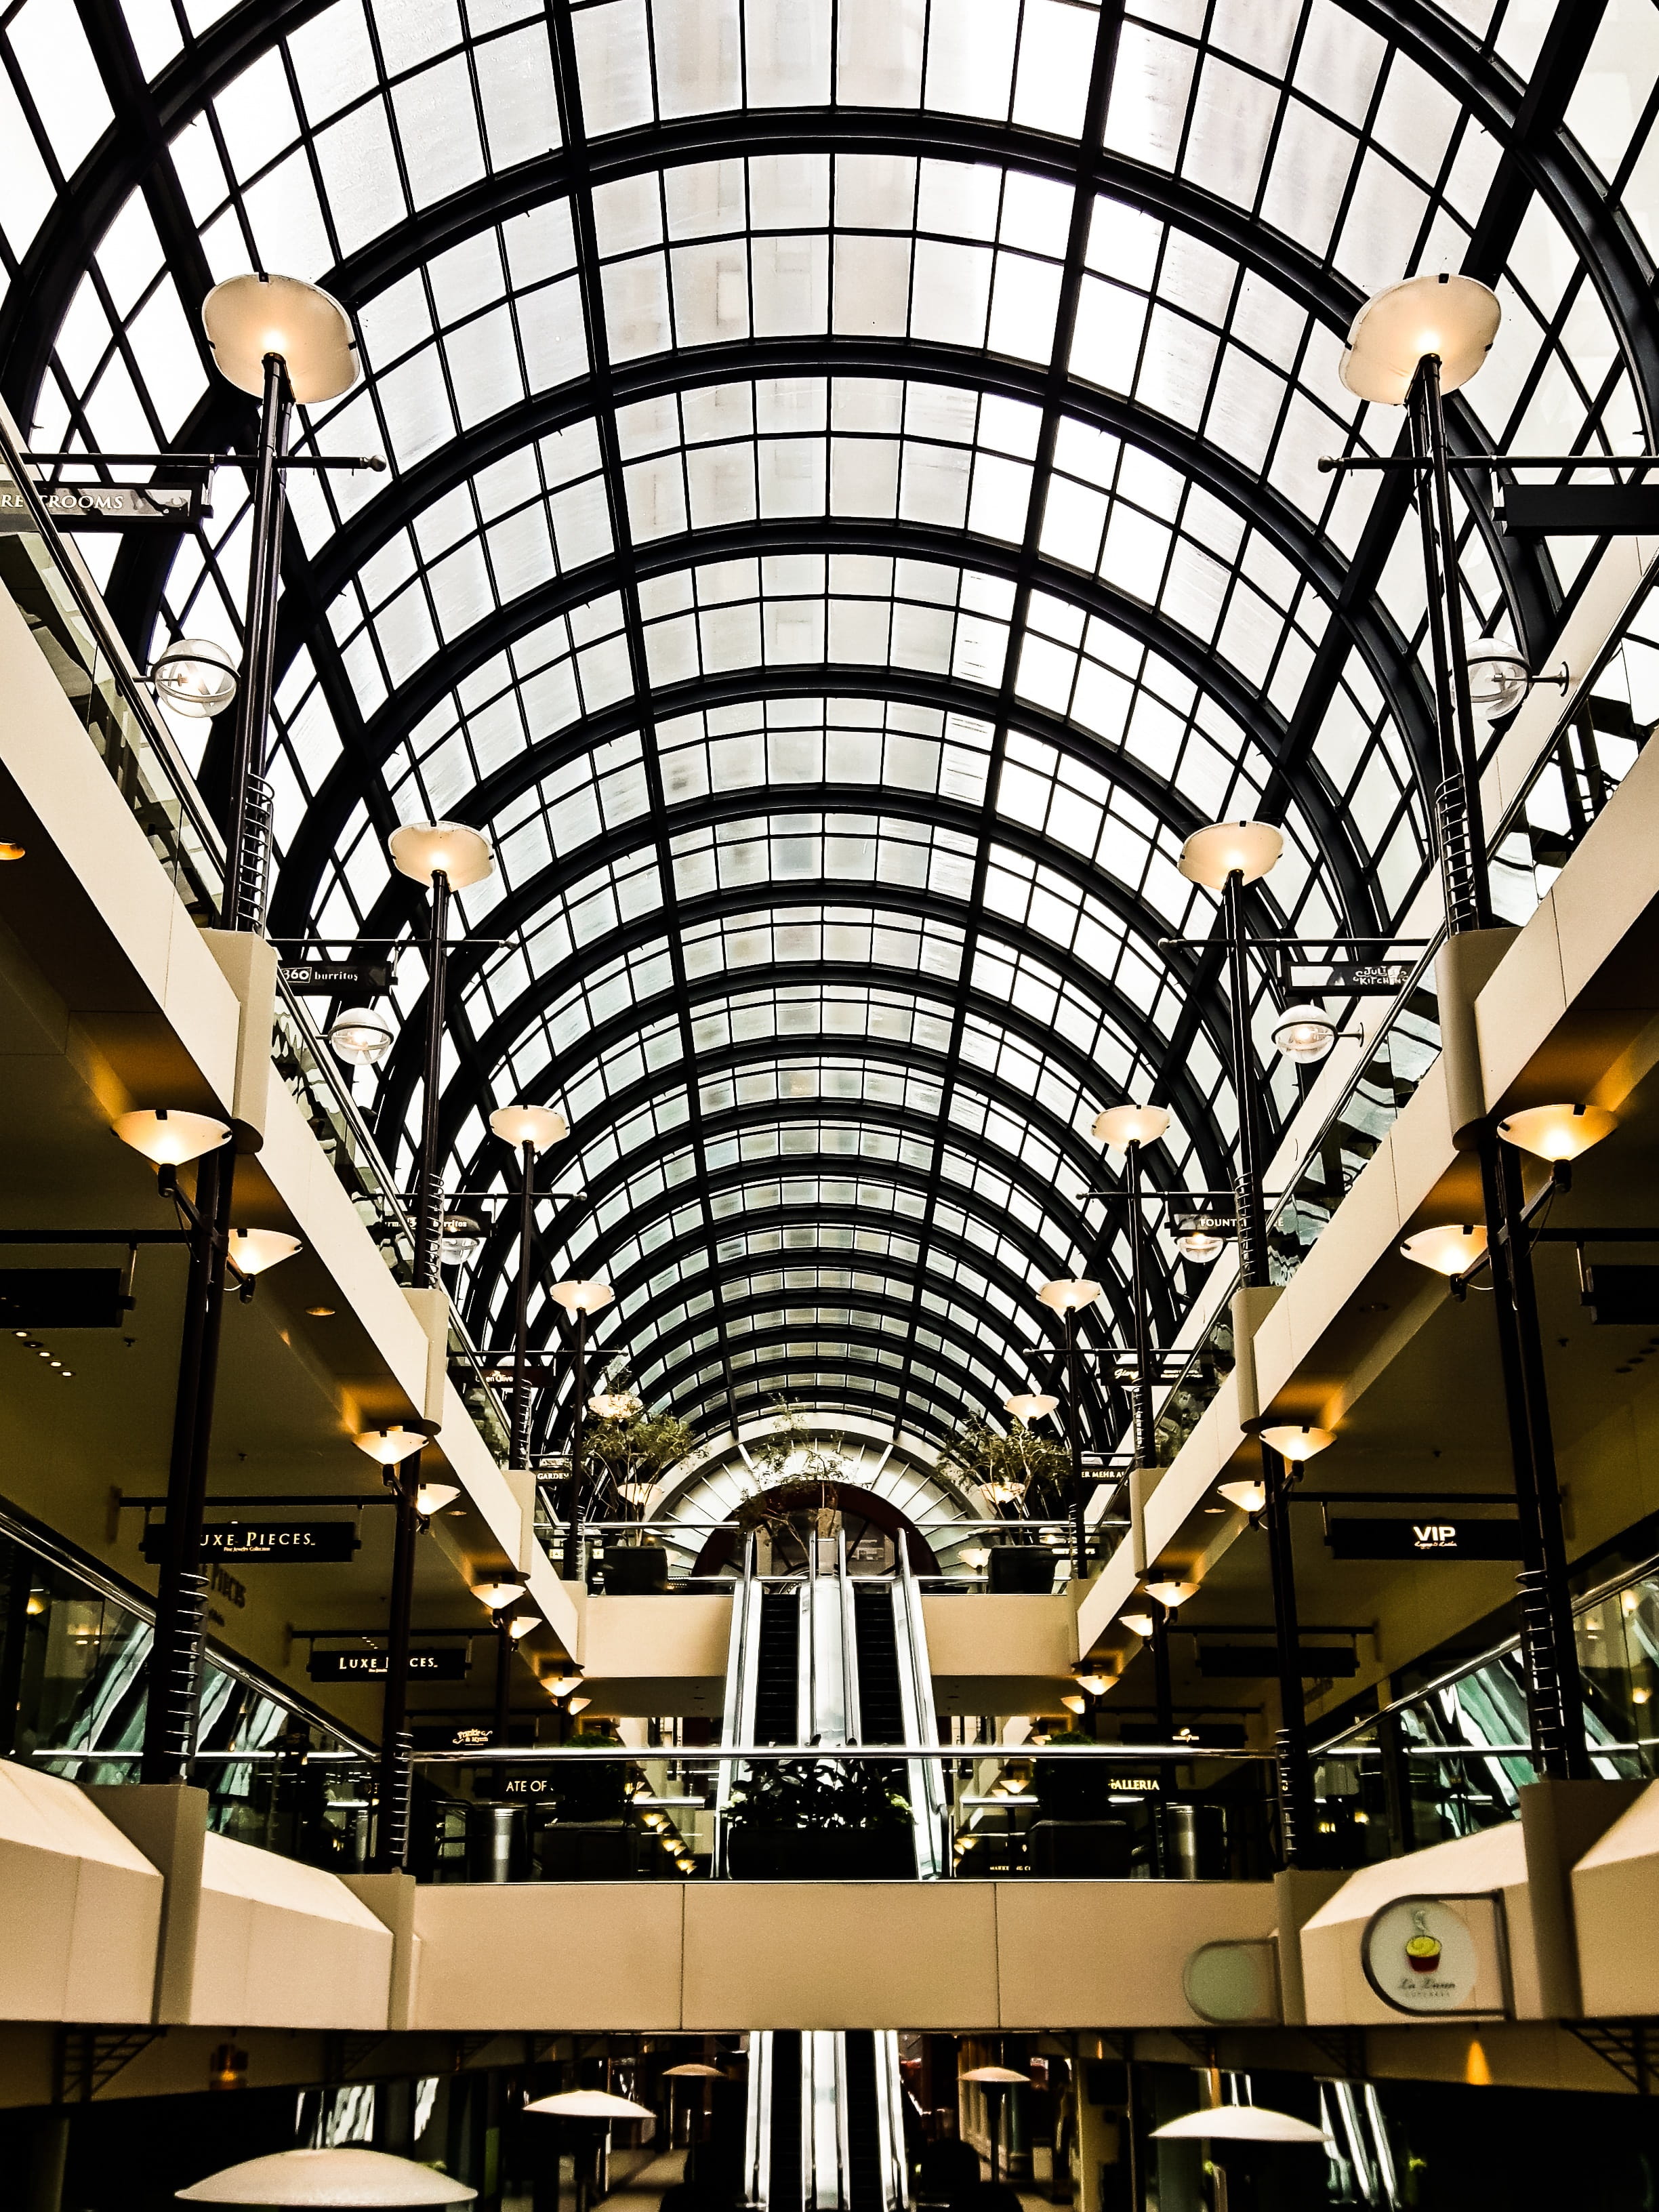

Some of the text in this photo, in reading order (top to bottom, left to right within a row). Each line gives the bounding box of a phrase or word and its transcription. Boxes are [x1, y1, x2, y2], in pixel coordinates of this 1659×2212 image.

[1, 494, 124, 509] RETROOMS
[283, 969, 358, 981] 360 burritos
[1359, 977, 1401, 985] KITCHN
[433, 1219, 467, 1227] brritos
[200, 1532, 311, 1547] UXE PIECES
[1413, 1526, 1456, 1541] VIP
[340, 1657, 377, 1669] LUXE
[530, 1780, 548, 1792] OF
